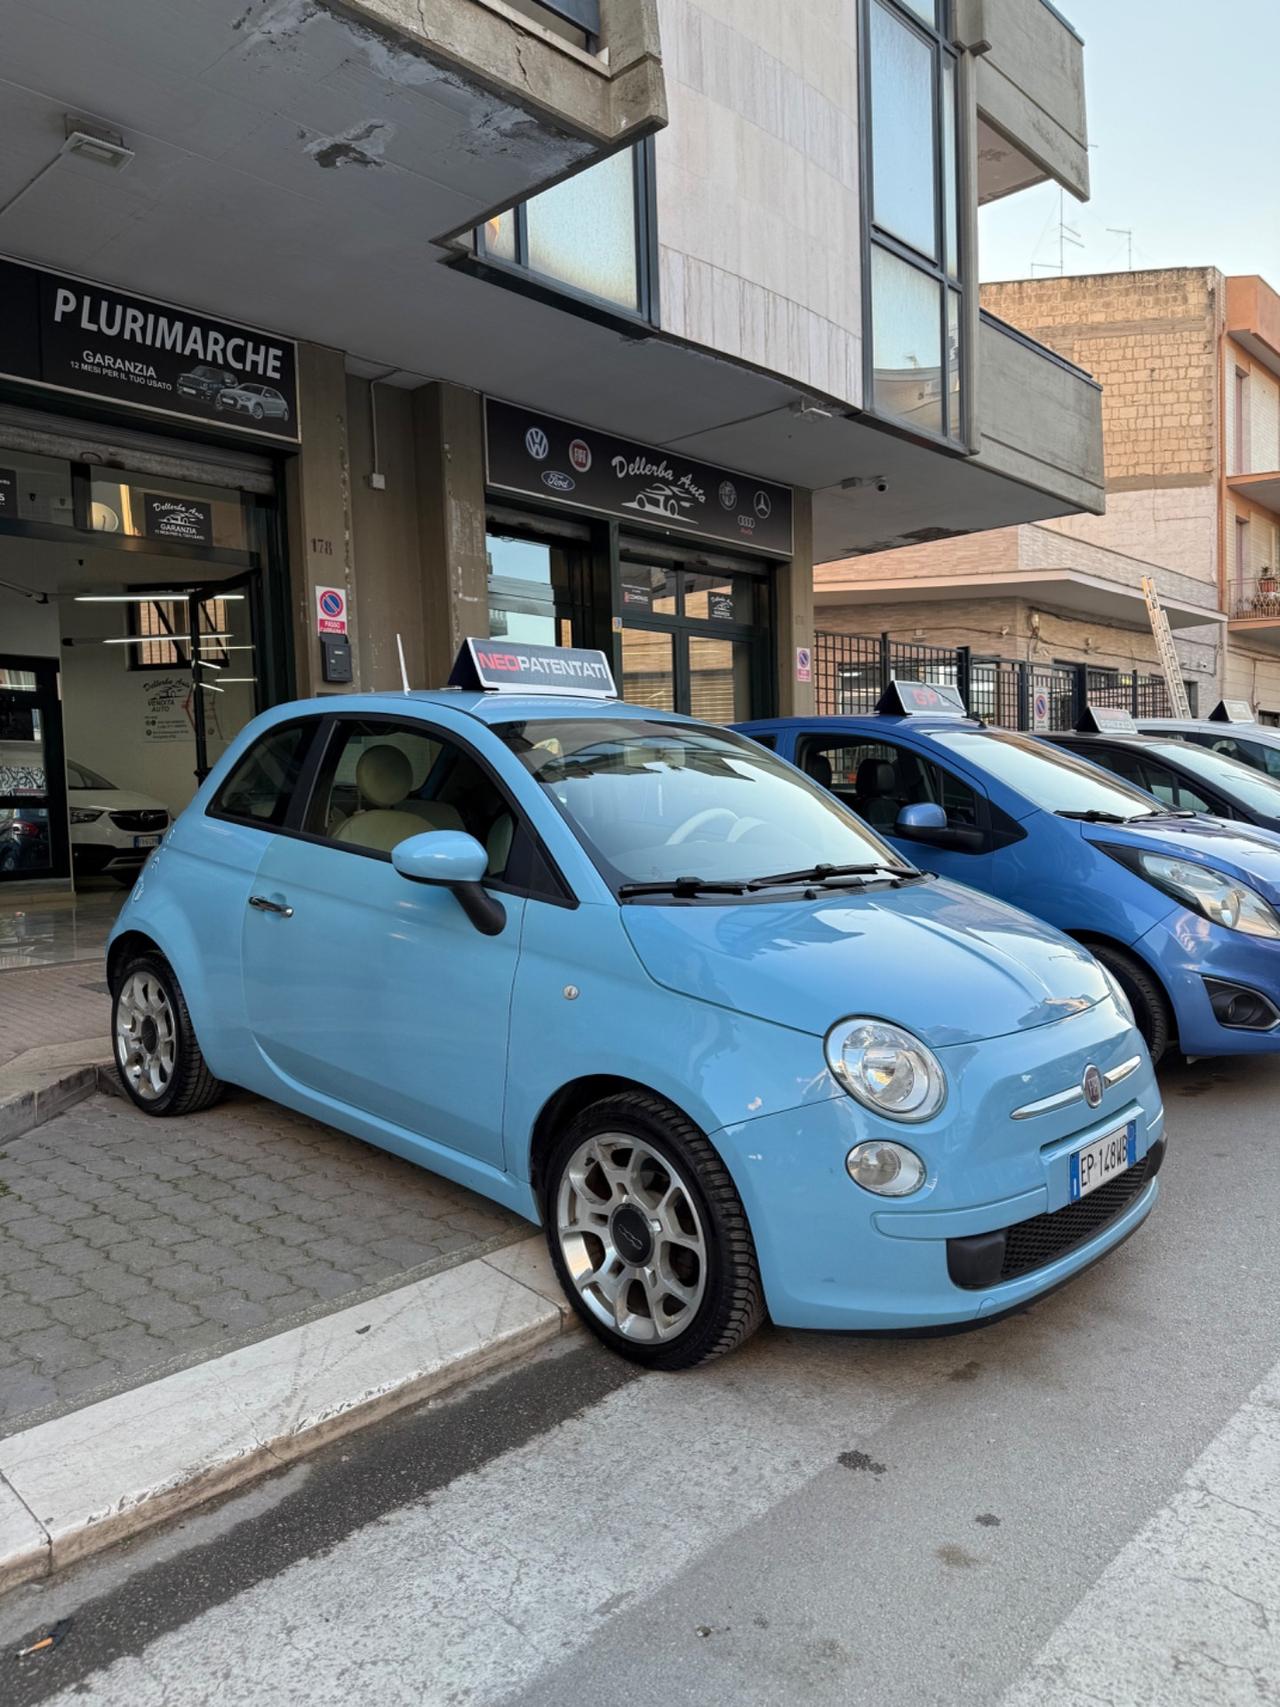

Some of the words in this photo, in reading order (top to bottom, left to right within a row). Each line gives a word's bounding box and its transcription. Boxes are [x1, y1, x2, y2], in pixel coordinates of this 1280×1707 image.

[54, 288, 283, 380] PLURIMARCHE
[70, 361, 80, 369] 12
[81, 363, 101, 374] MESI
[102, 368, 119, 378] PER
[129, 375, 146, 385] TUO
[147, 379, 172, 391] USATO
[82, 350, 157, 379] GARANZIA
[611, 456, 674, 478] Dellerba
[677, 473, 706, 503] Auto
[478, 652, 607, 678] NEOPATENTATI
[1080, 1153, 1096, 1187] EP
[1099, 1134, 1128, 1176] 148WB
